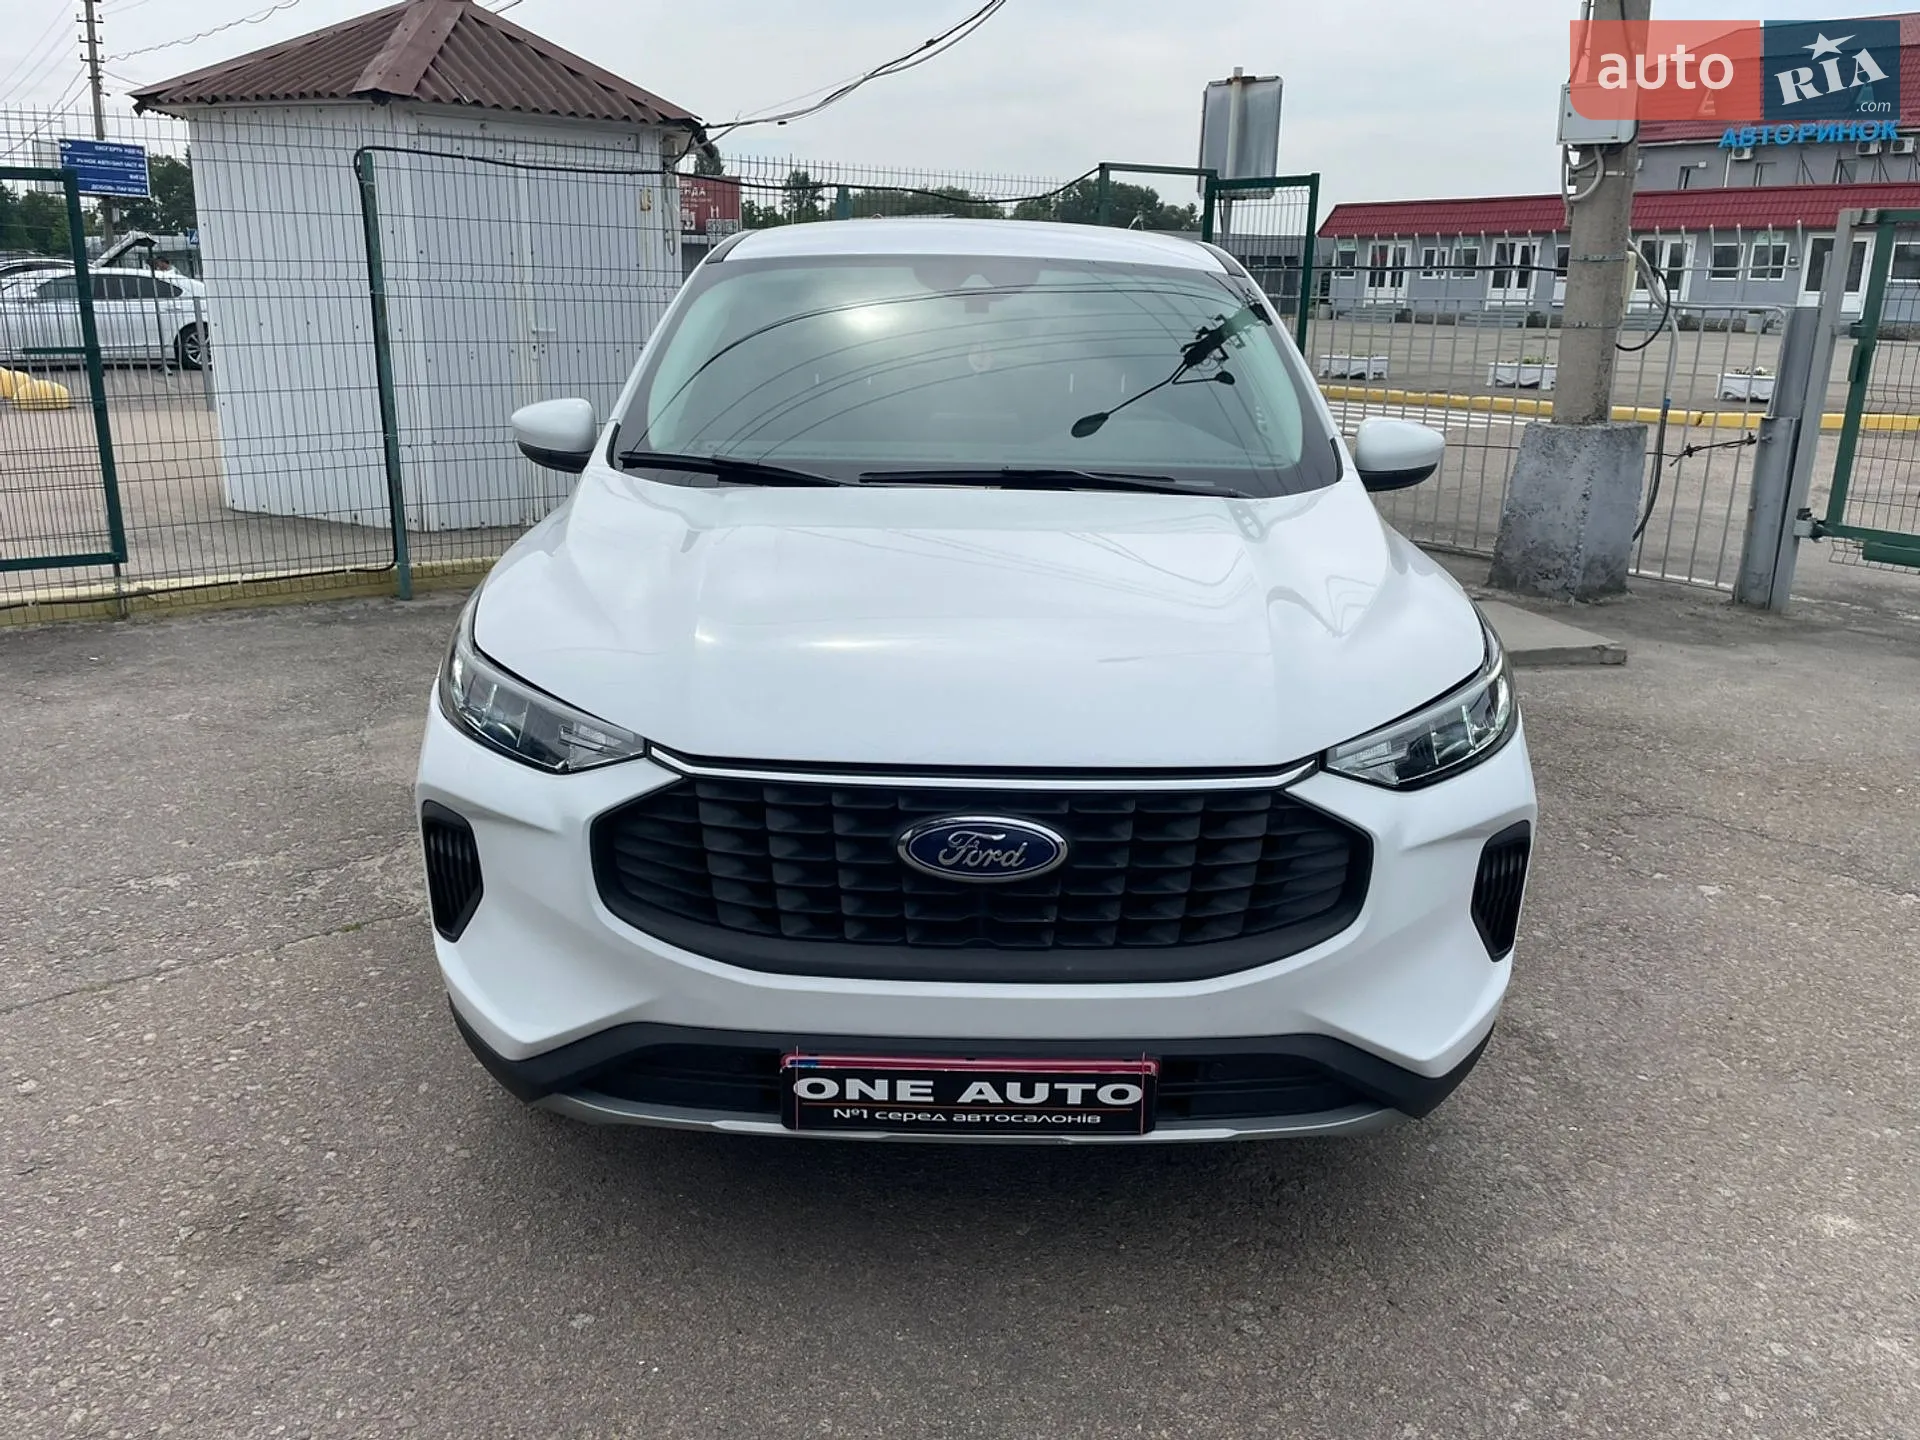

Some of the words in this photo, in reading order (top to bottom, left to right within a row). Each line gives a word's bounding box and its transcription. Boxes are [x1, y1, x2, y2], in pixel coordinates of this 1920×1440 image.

[1718, 119, 1899, 148] АВТОРИНОК
[938, 830, 1028, 867] Ford
[793, 1077, 934, 1102] ONE
[956, 1081, 1143, 1105] AUTO
[875, 1111, 947, 1122] серед
[952, 1112, 1101, 1124] автосалонів
